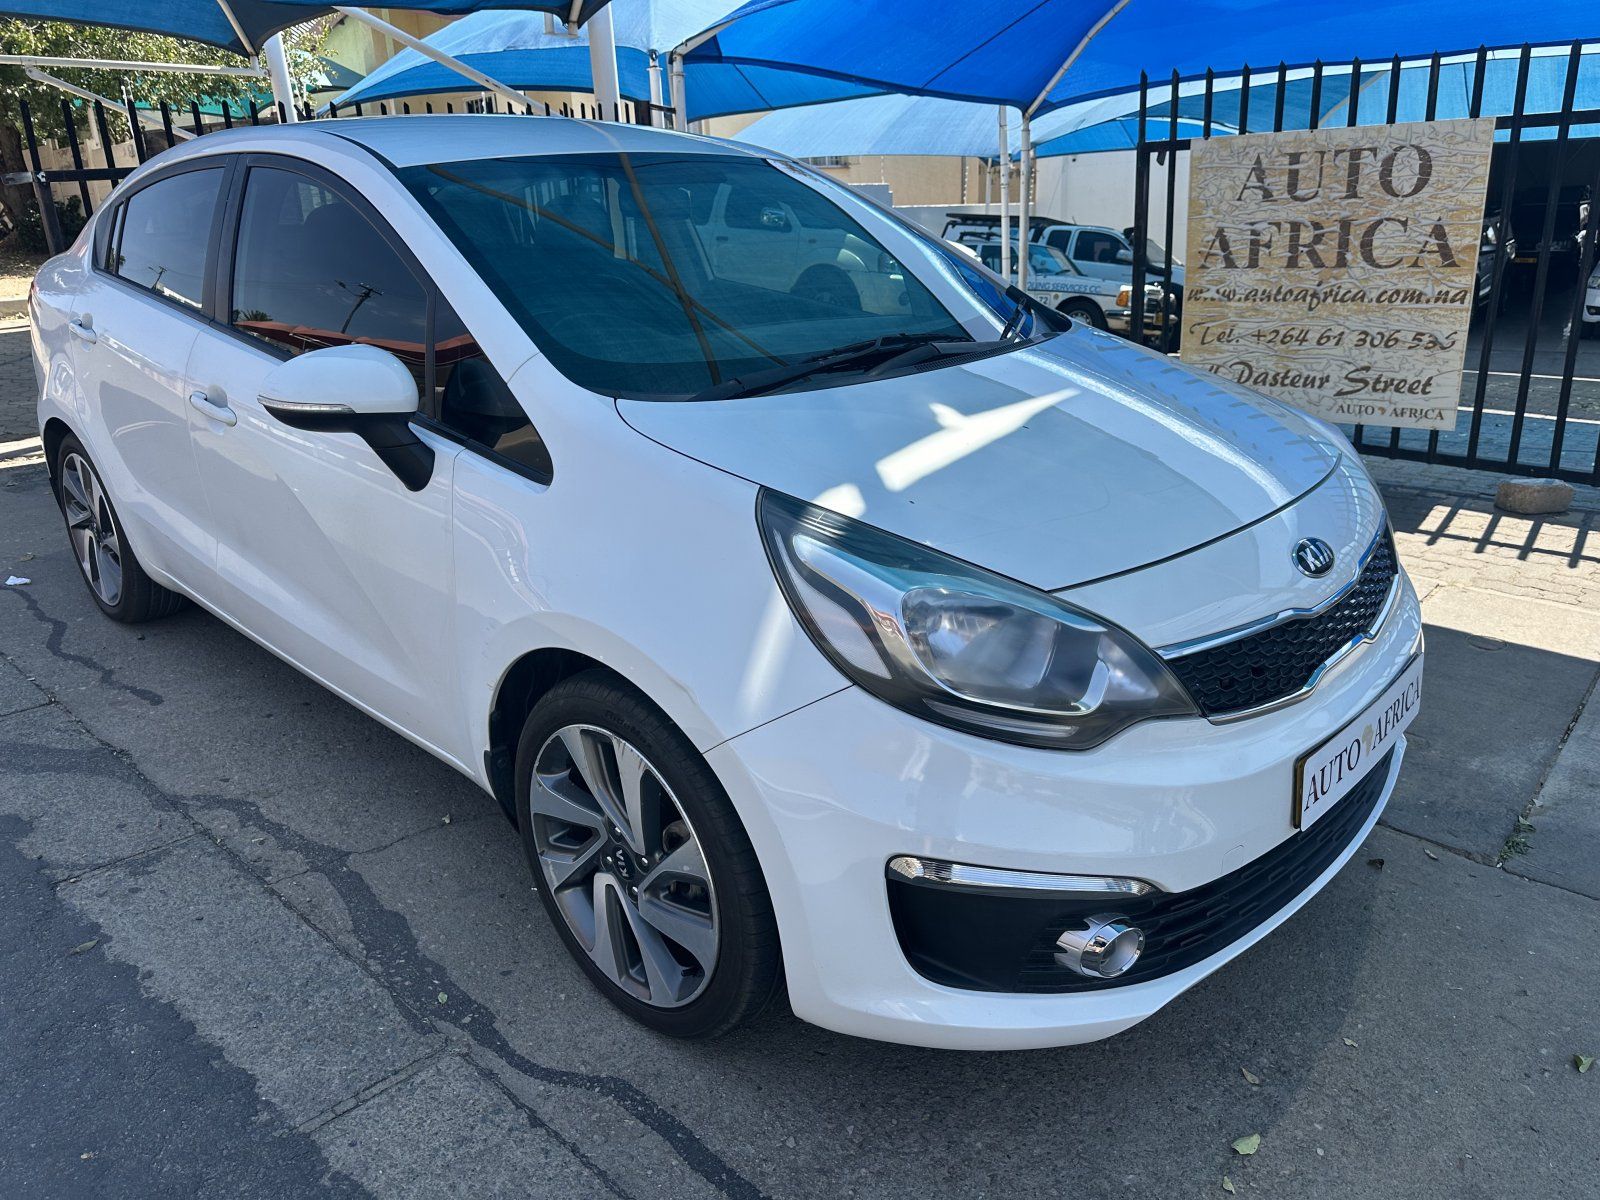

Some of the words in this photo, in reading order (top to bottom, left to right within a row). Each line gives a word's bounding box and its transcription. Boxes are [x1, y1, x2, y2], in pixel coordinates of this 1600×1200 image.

[1237, 144, 1433, 202] AUTO
[1198, 216, 1461, 270] AFRICA
[1251, 327, 1308, 347] +264
[1316, 330, 1345, 347] 61
[1354, 330, 1401, 349] 306
[1333, 366, 1433, 397] Street
[1336, 403, 1375, 416] AUTO
[1389, 406, 1444, 422] AFRICA
[1298, 544, 1334, 571] KIA
[1303, 738, 1361, 812] AUTO
[1371, 675, 1421, 750] AFRICA
